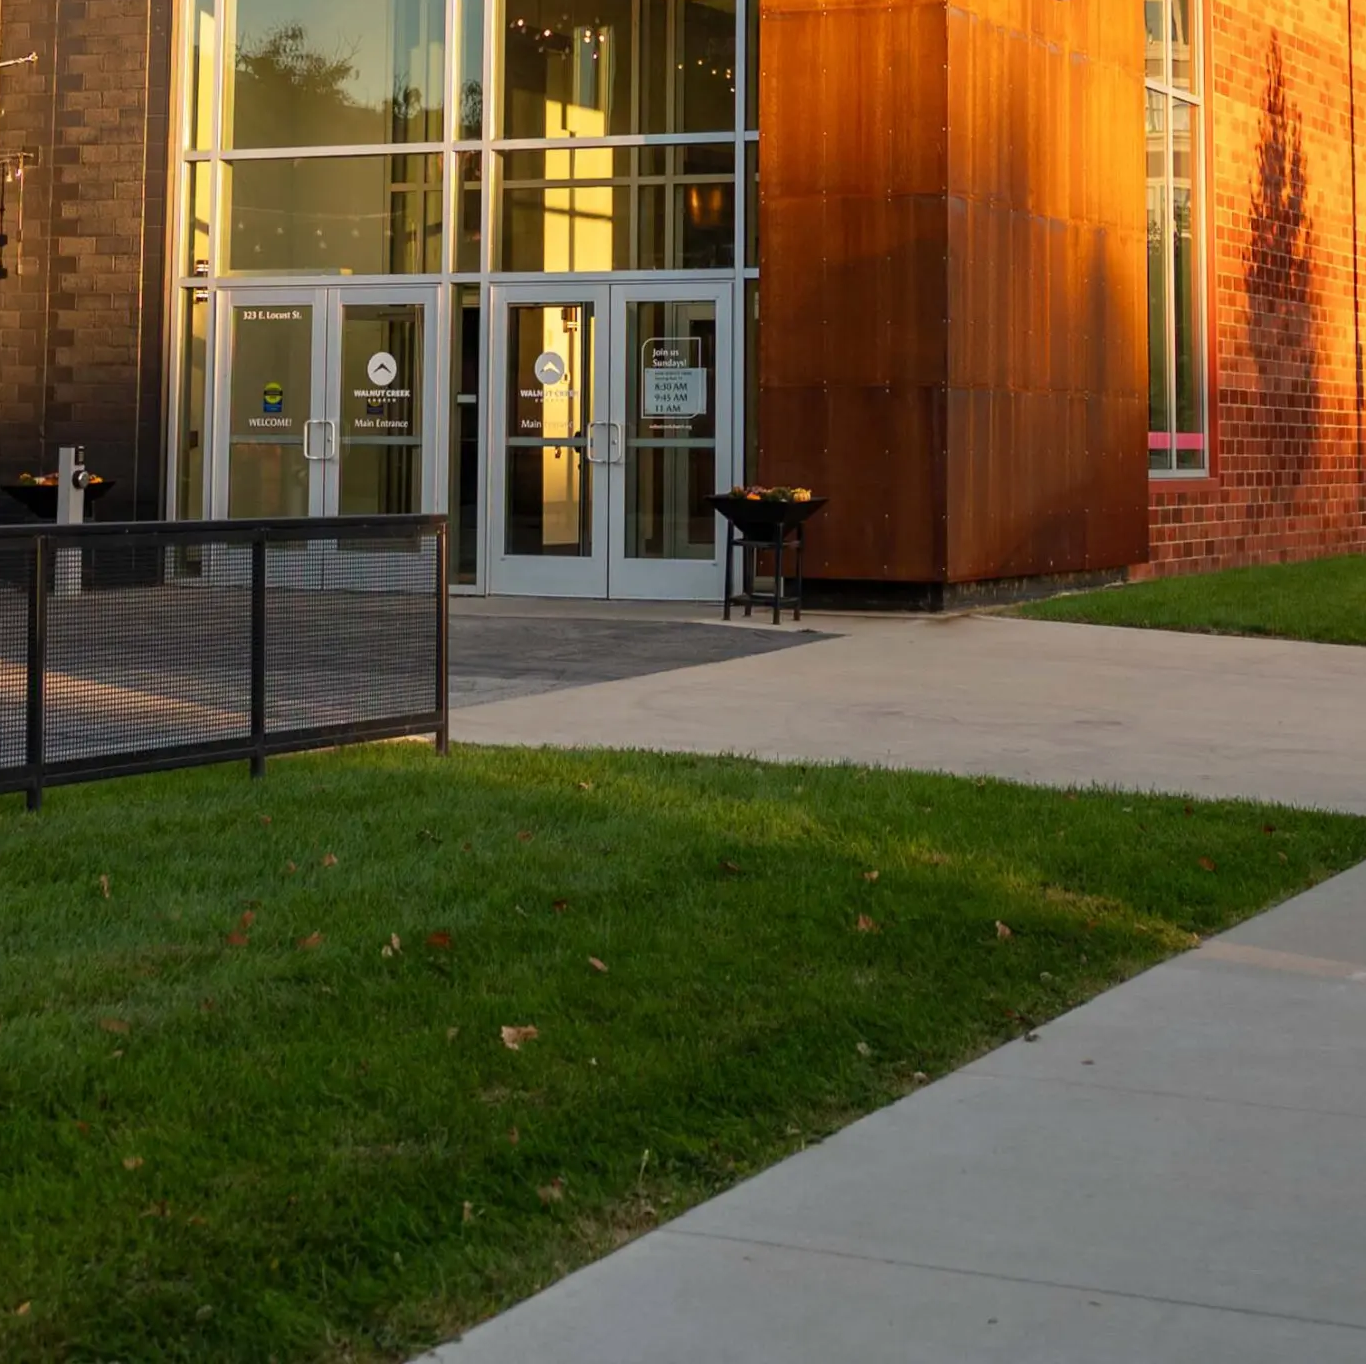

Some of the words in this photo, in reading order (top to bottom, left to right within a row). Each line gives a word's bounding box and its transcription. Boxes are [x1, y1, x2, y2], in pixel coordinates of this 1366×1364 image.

[266, 311, 291, 320] Locust
[653, 347, 668, 358] Join
[653, 358, 687, 367] Sundays!
[655, 382, 672, 391] 8:30
[673, 382, 688, 391] AM
[353, 389, 385, 398] WALNUT
[386, 389, 411, 398] CREEK
[655, 393, 671, 402] 9:45
[673, 393, 688, 402] AM
[655, 404, 663, 413] 11
[666, 404, 681, 413] AM
[248, 417, 293, 427] WELCOME!
[354, 418, 374, 428] Main
[376, 418, 409, 428] Entrance
[521, 419, 542, 429] Main
